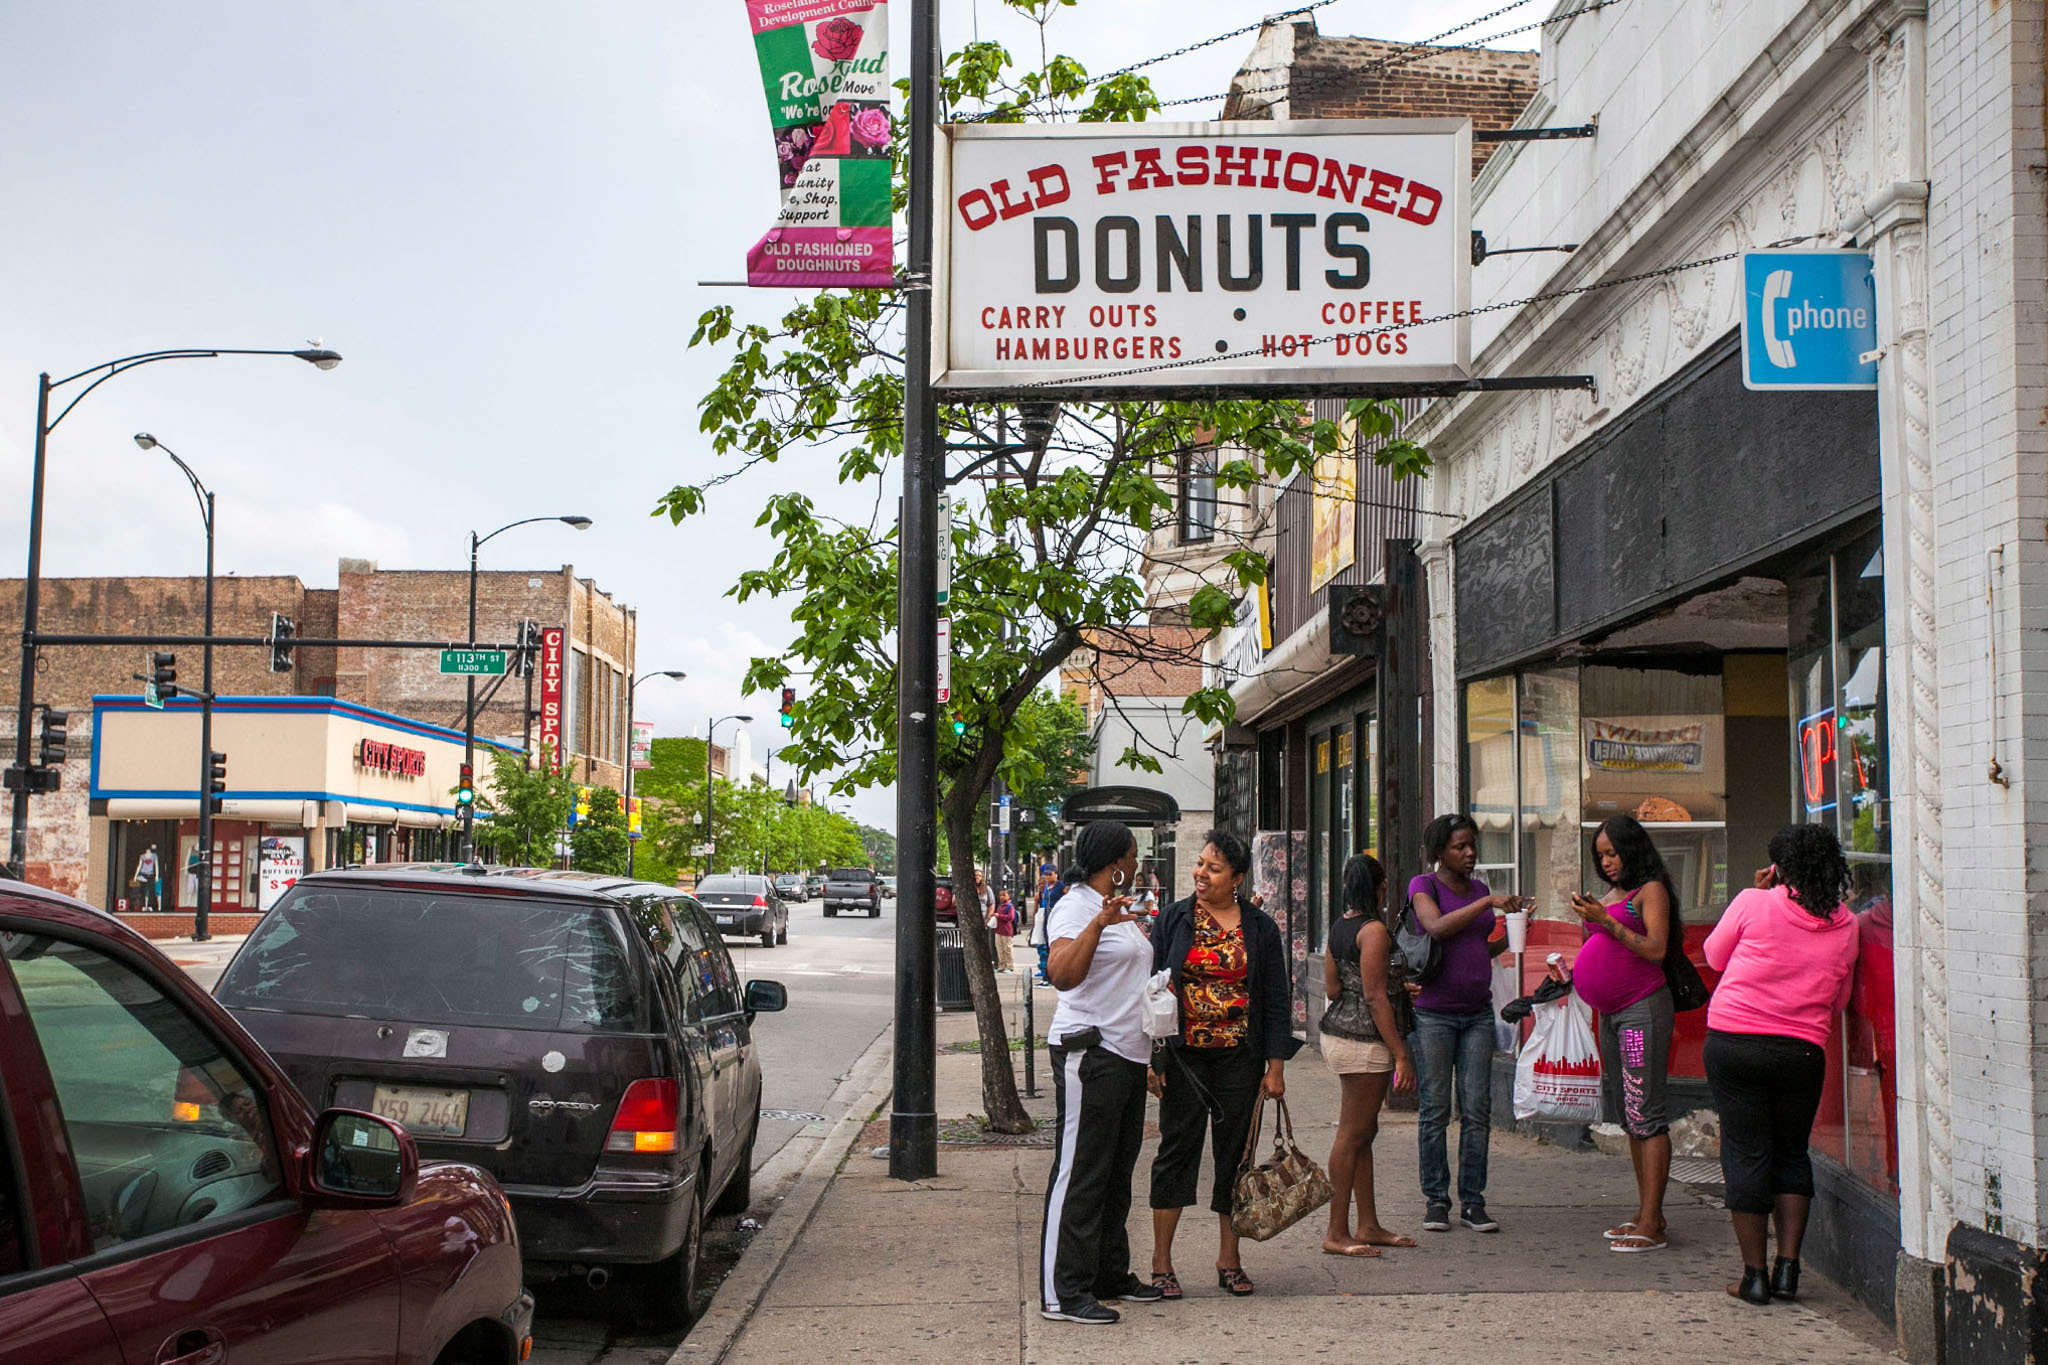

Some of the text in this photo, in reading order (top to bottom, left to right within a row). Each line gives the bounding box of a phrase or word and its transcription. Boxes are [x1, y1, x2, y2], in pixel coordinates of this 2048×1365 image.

[758, 2, 836, 28] Development
[802, 191, 838, 208] Shop,
[957, 145, 1444, 231] OLD FASHIONED
[778, 208, 829, 224] Support
[764, 243, 873, 256] OLD FASHIONED
[1033, 212, 1371, 294] DONUTS
[776, 259, 861, 272] DOUGHNUTS
[980, 300, 1423, 330] CARRY OUTS COFFEE
[1787, 299, 1867, 336] phone
[995, 333, 1408, 361] HAMBURGERS HOT DOGS
[447, 653, 500, 664] E 113TH ST
[545, 632, 560, 692] CITY
[543, 702, 559, 774] SPO
[361, 738, 426, 777] CITY SPORTS
[273, 858, 303, 866] SALE
[1535, 1084, 1597, 1095] CITY SPORTS
[419, 1102, 461, 1127] 2464
[528, 1099, 602, 1112] ODYSSEY
